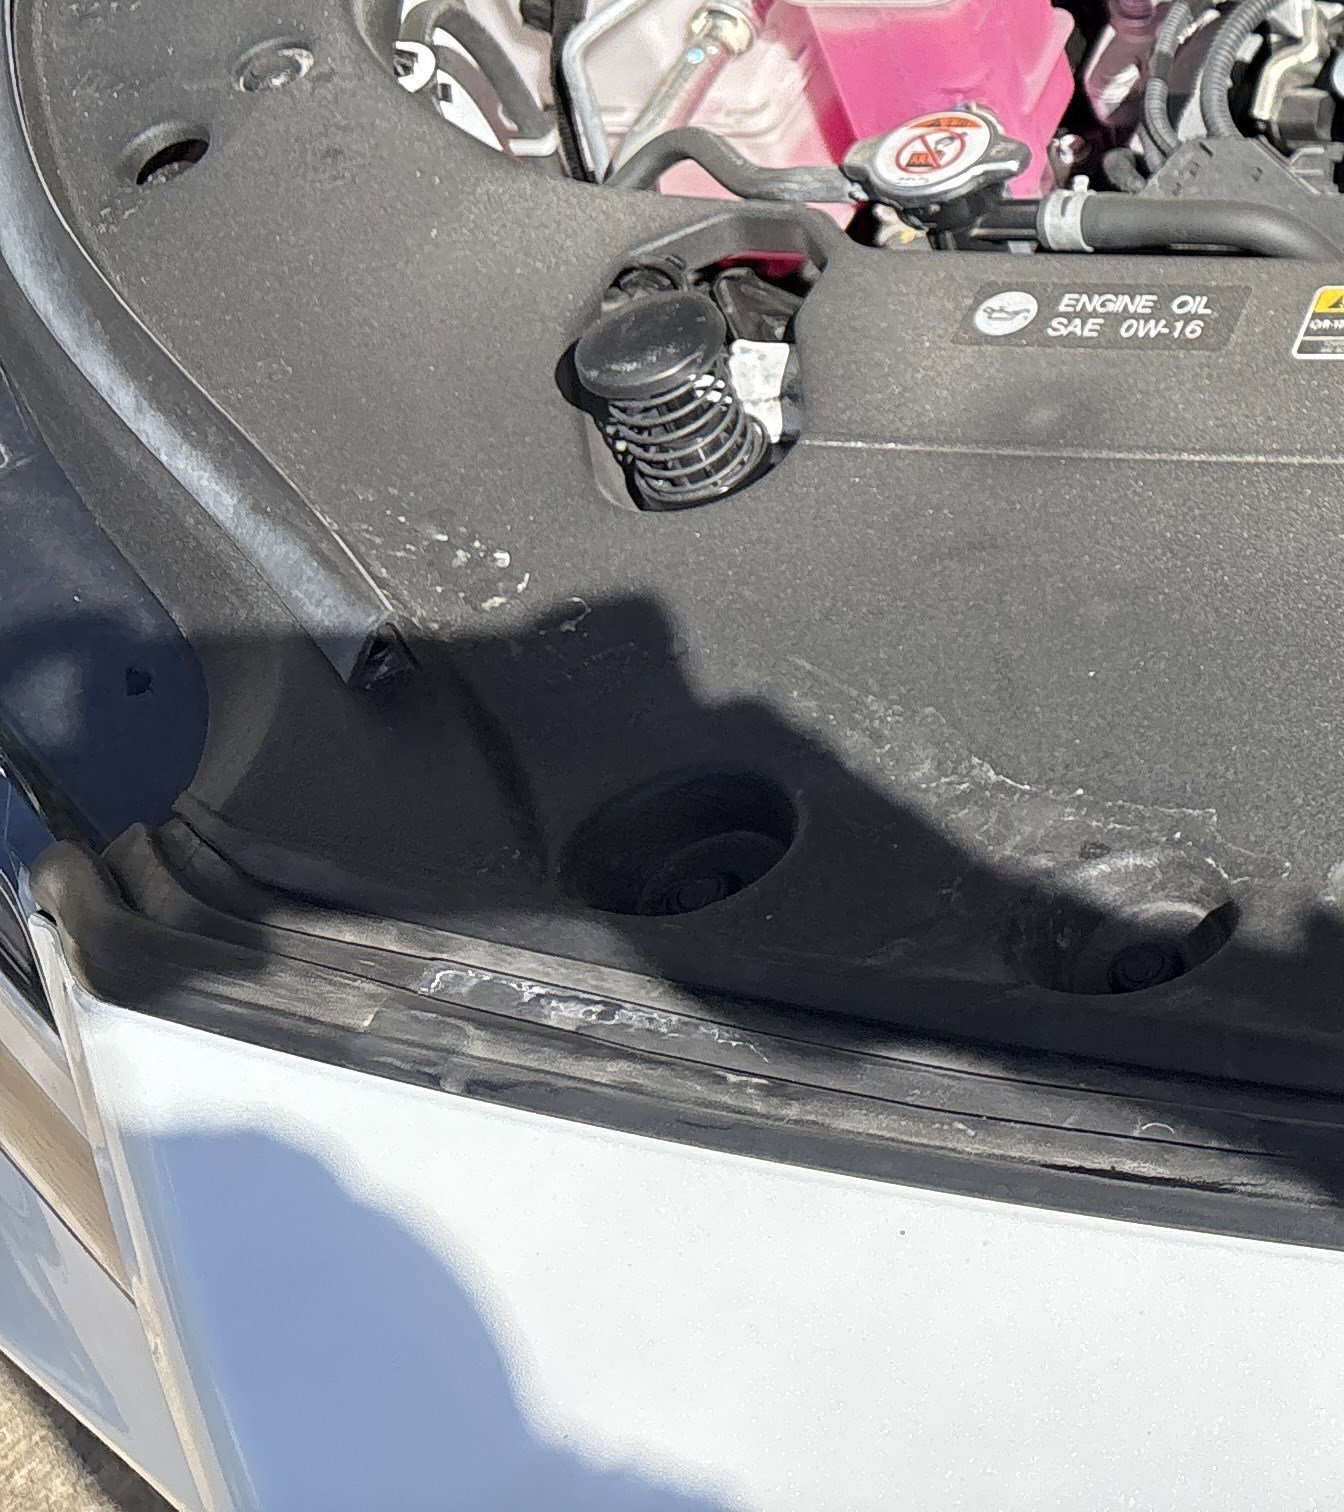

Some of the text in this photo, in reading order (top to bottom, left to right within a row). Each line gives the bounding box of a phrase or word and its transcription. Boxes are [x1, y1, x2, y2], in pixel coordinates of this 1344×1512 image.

[1057, 292, 1213, 315] ENGINE OIL
[1046, 317, 1206, 340] SAE 0W-16
